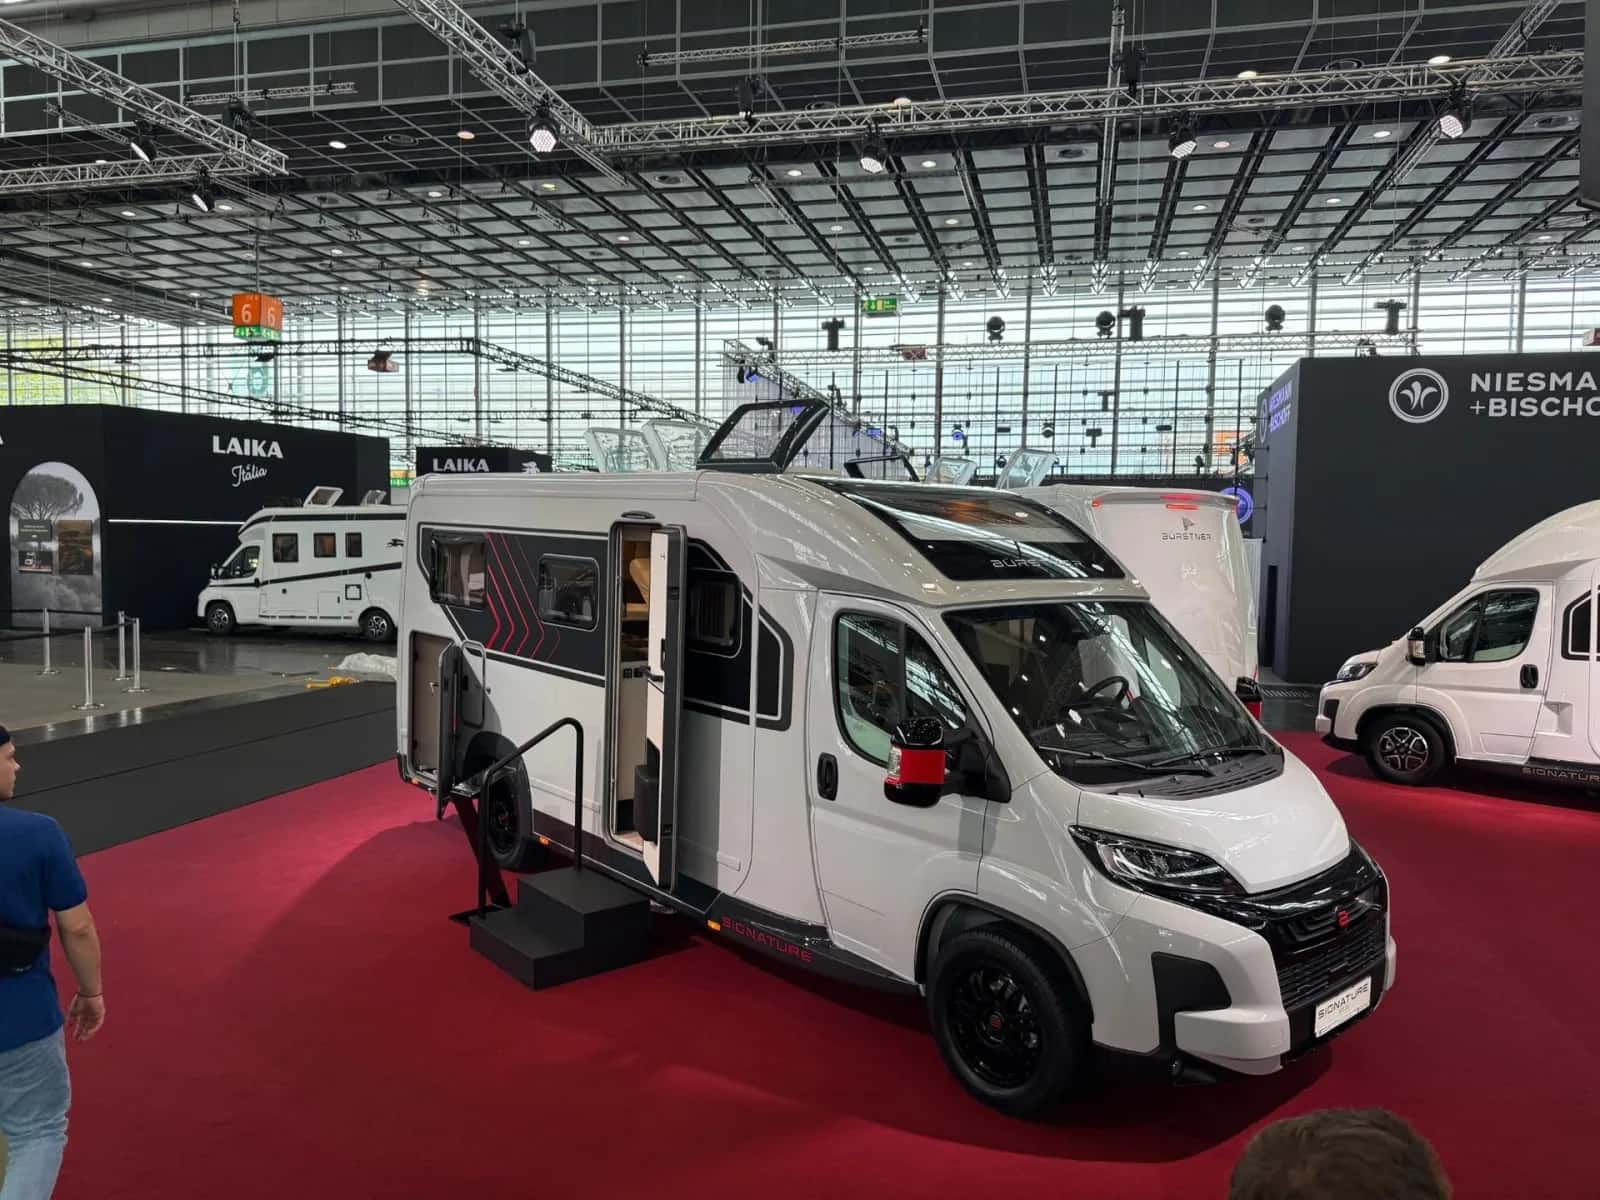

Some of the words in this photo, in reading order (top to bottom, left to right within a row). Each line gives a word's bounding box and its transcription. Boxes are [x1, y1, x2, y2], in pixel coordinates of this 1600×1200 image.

[241, 303, 252, 323] 6
[267, 307, 276, 327] 6
[212, 435, 284, 459] LAIKA
[432, 458, 490, 472] LAIKA
[721, 915, 813, 962] SIGNATURE
[1317, 983, 1369, 1019] SIGNATURE
